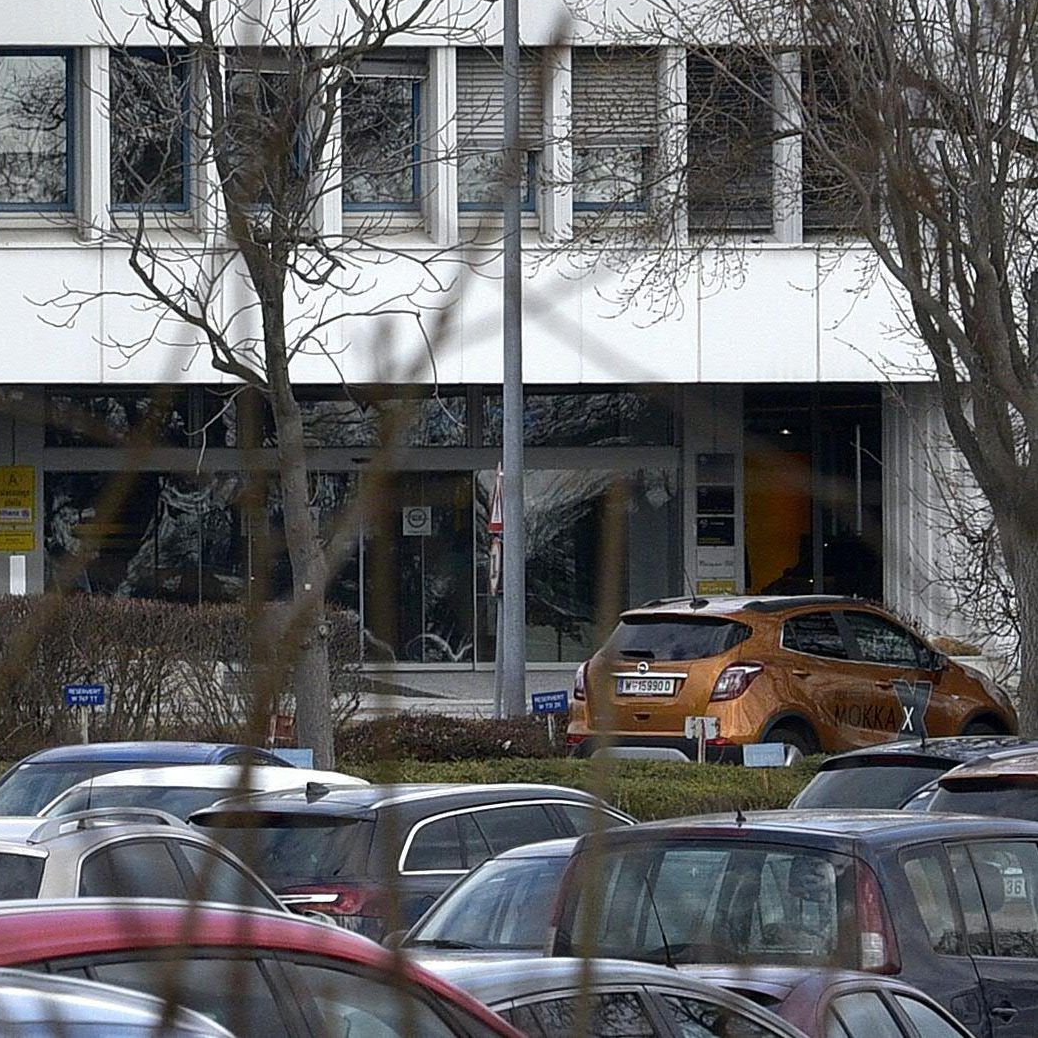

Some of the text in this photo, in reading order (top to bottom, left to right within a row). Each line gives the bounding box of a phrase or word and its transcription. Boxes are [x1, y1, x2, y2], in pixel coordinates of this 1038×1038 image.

[834, 703, 915, 732] MOKKA X
[1006, 880, 1022, 895] 36
